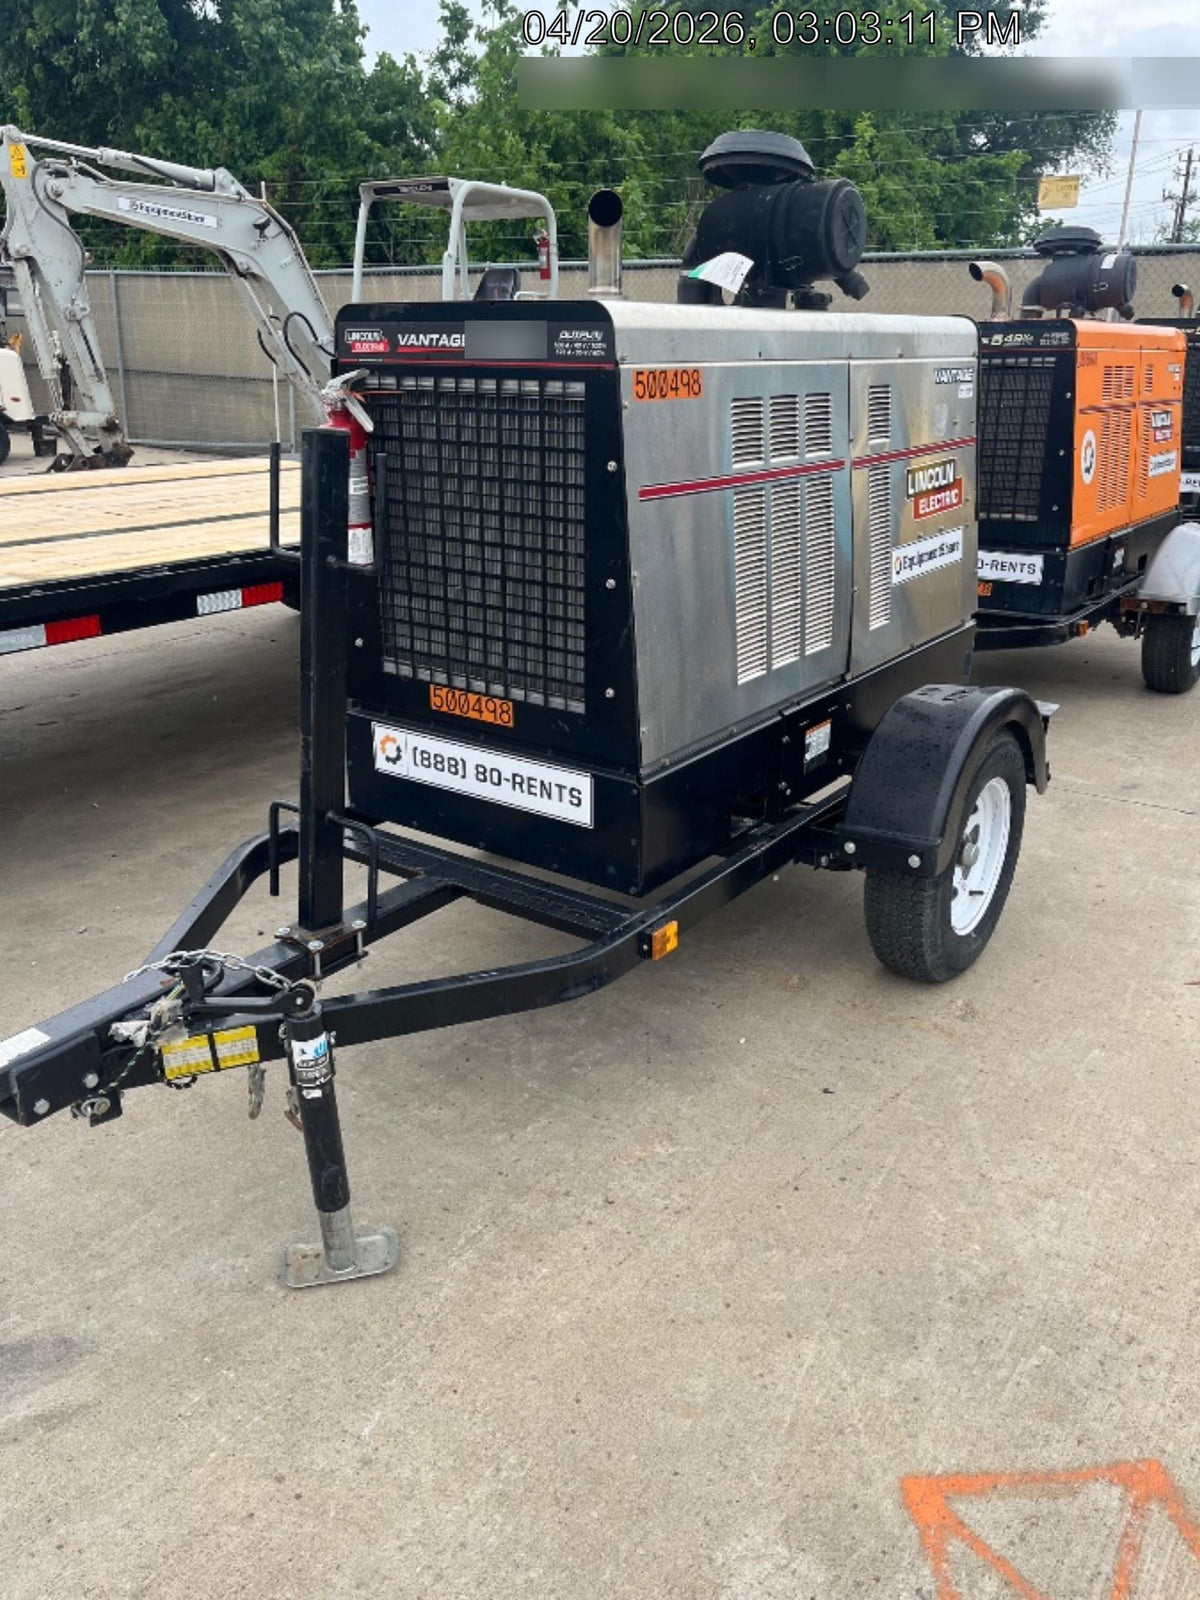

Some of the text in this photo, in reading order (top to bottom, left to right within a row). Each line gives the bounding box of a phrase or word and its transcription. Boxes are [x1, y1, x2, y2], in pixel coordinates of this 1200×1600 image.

[397, 333, 466, 347] VANTAG
[635, 369, 702, 399] 500498
[908, 461, 954, 495] LINCOLN
[919, 488, 960, 514] ELECTRIC
[433, 687, 513, 725] 500498
[413, 747, 583, 808] (888) 80-RENTS
